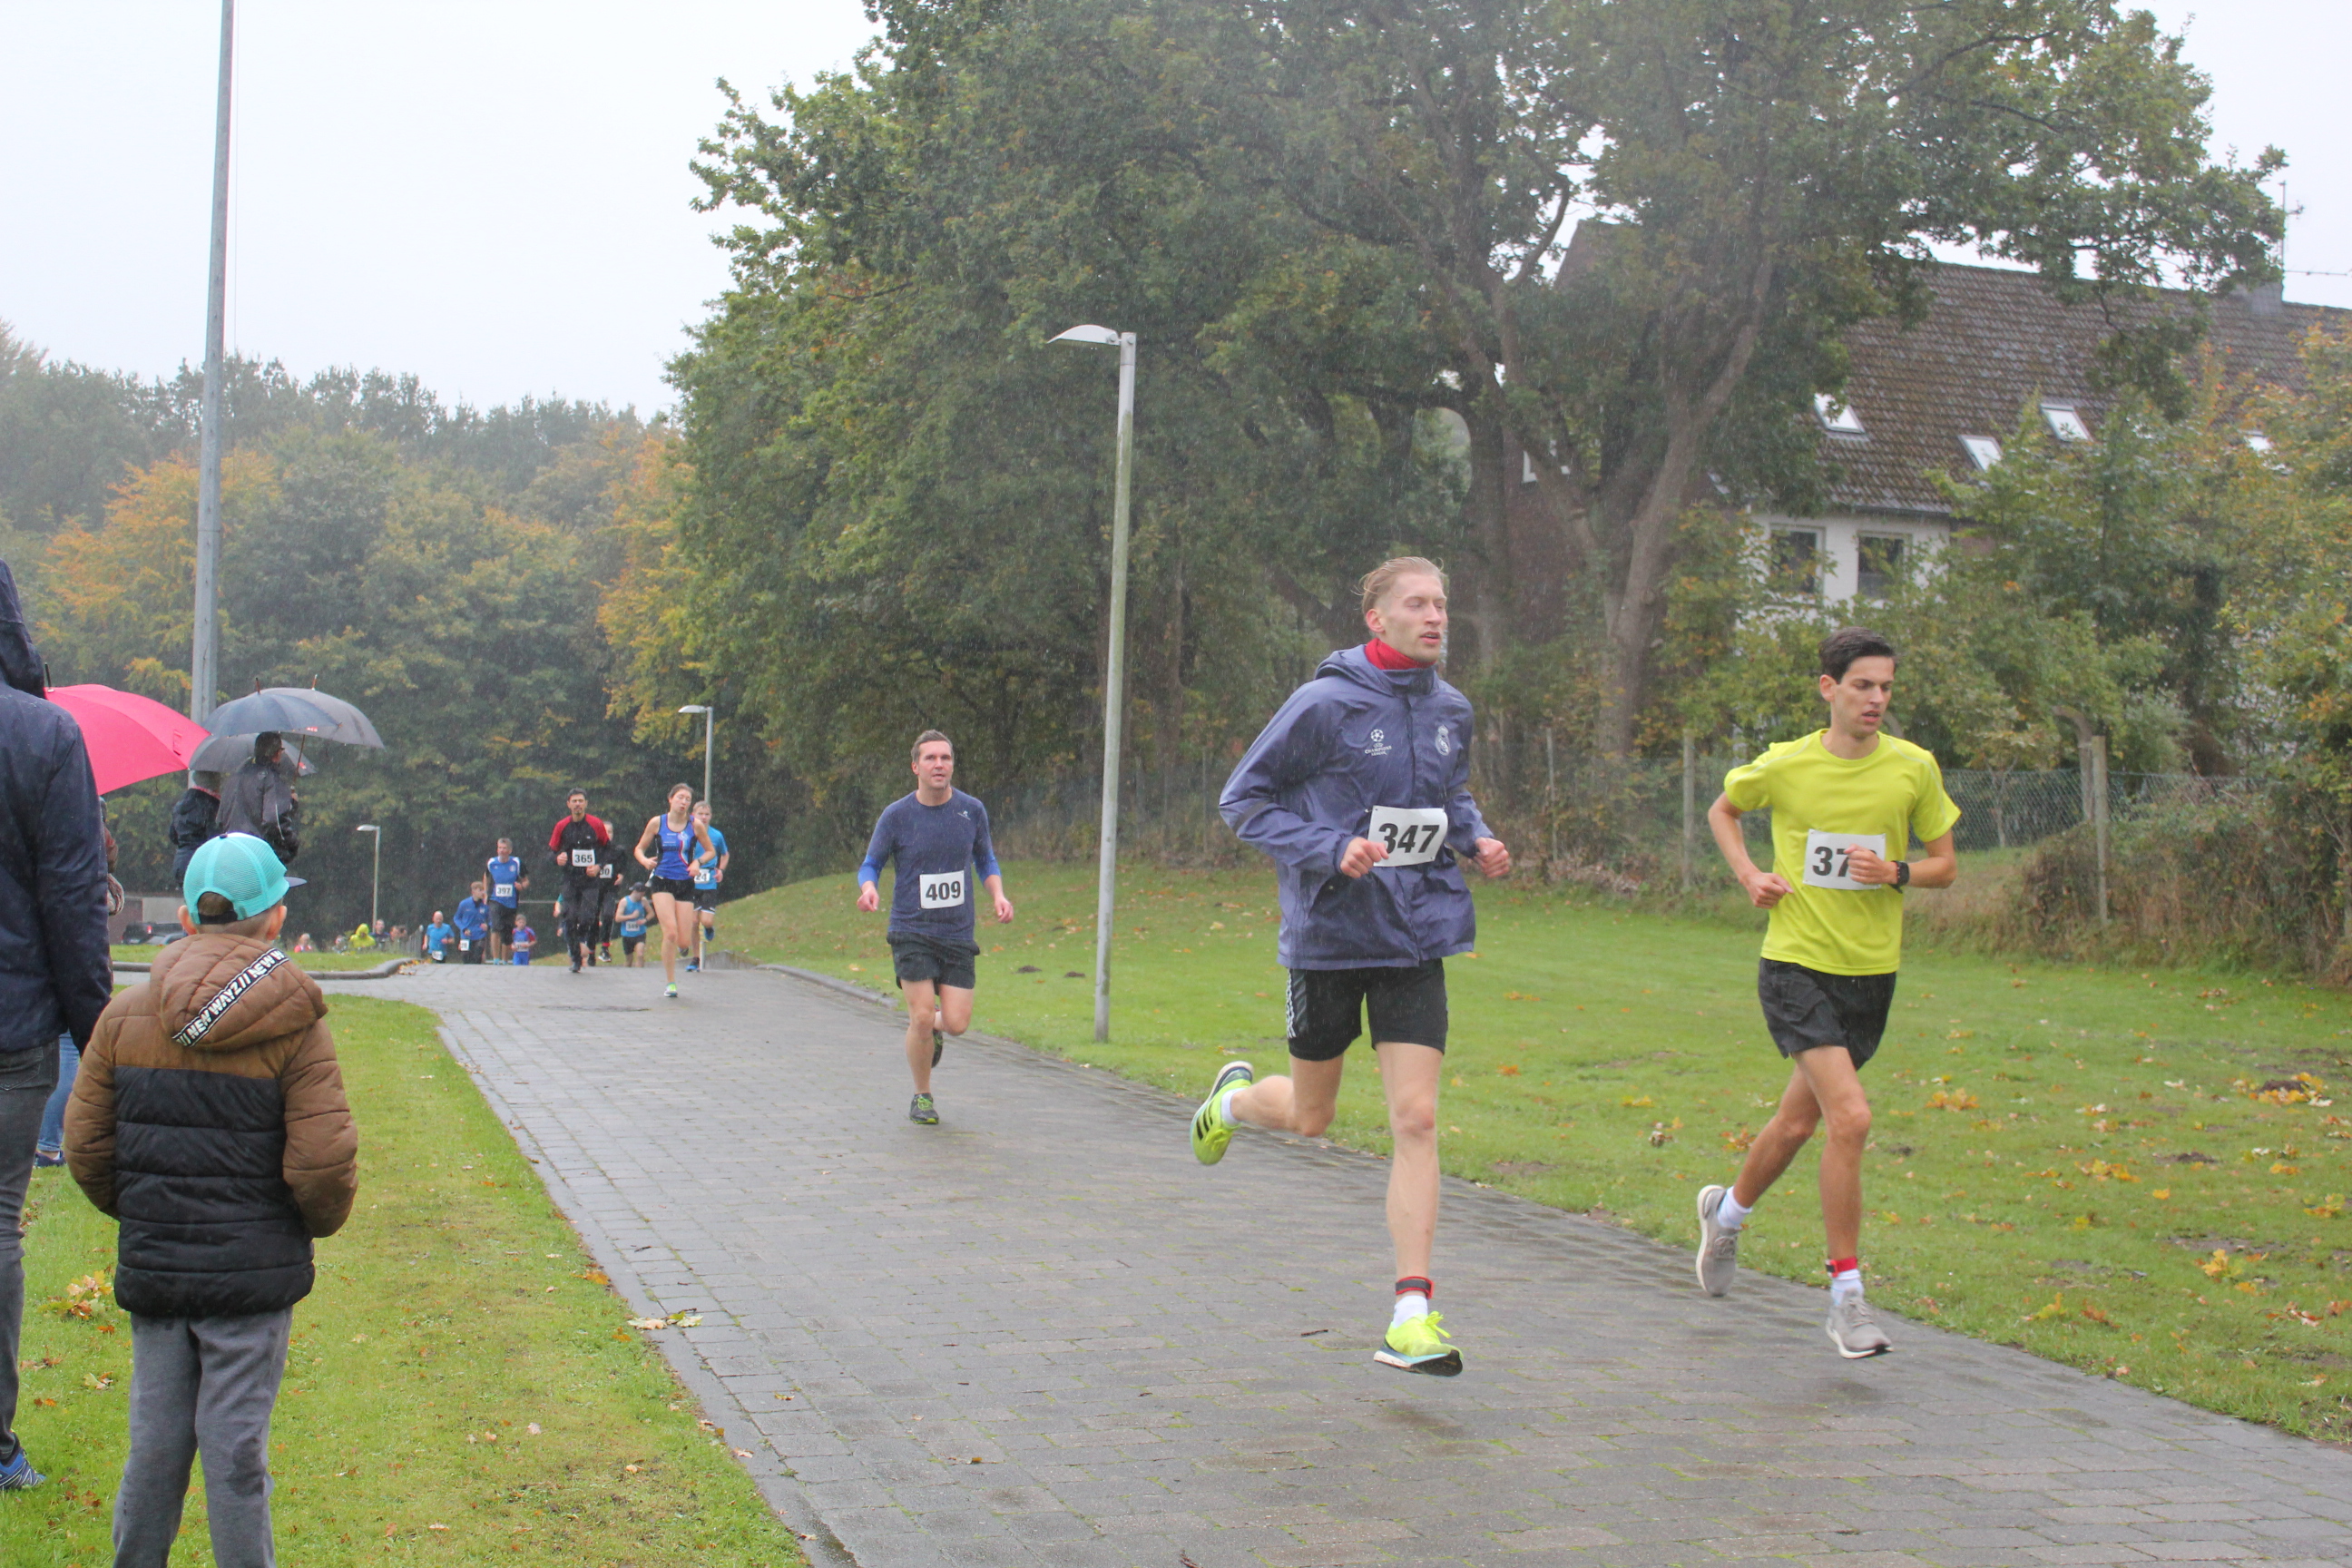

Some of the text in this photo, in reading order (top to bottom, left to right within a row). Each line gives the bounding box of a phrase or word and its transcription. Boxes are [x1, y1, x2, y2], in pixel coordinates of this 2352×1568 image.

[1378, 823, 1440, 854] 347
[574, 855, 593, 863] 365
[1812, 846, 1875, 877] 37
[696, 873, 707, 881] 24
[926, 880, 961, 901] 409
[186, 1009, 212, 1040] NEW
[247, 955, 276, 978] NEW
